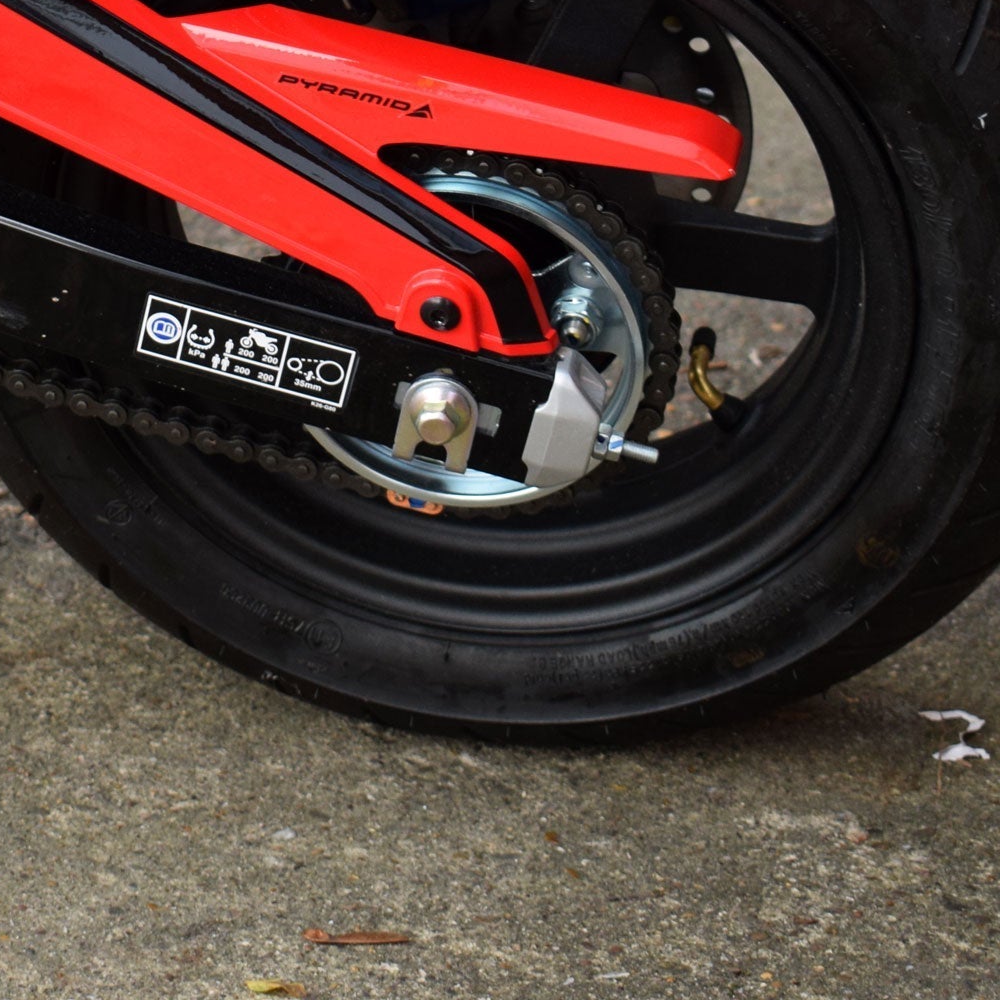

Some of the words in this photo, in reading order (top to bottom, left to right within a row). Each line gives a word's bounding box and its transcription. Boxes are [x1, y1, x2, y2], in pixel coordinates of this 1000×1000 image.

[278, 74, 411, 112] PYRAMID
[187, 347, 206, 359] kPa
[237, 347, 255, 358] 200
[261, 354, 279, 365] 200
[233, 364, 251, 376] 200
[257, 371, 275, 383] 200
[293, 378, 322, 392] 35mm
